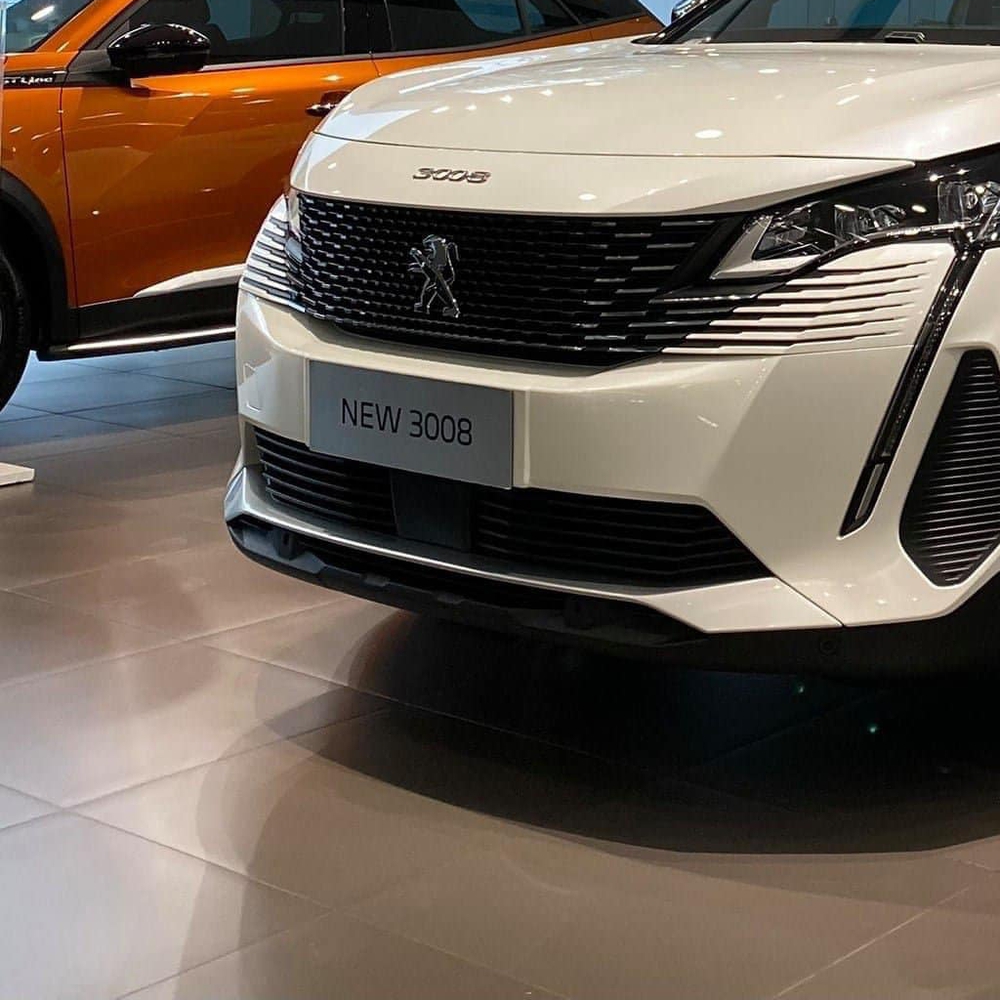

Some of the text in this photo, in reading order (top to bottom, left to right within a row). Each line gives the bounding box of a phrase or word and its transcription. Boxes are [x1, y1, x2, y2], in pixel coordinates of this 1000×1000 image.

[412, 167, 491, 184] 3008
[341, 397, 473, 446] NEW 3008
